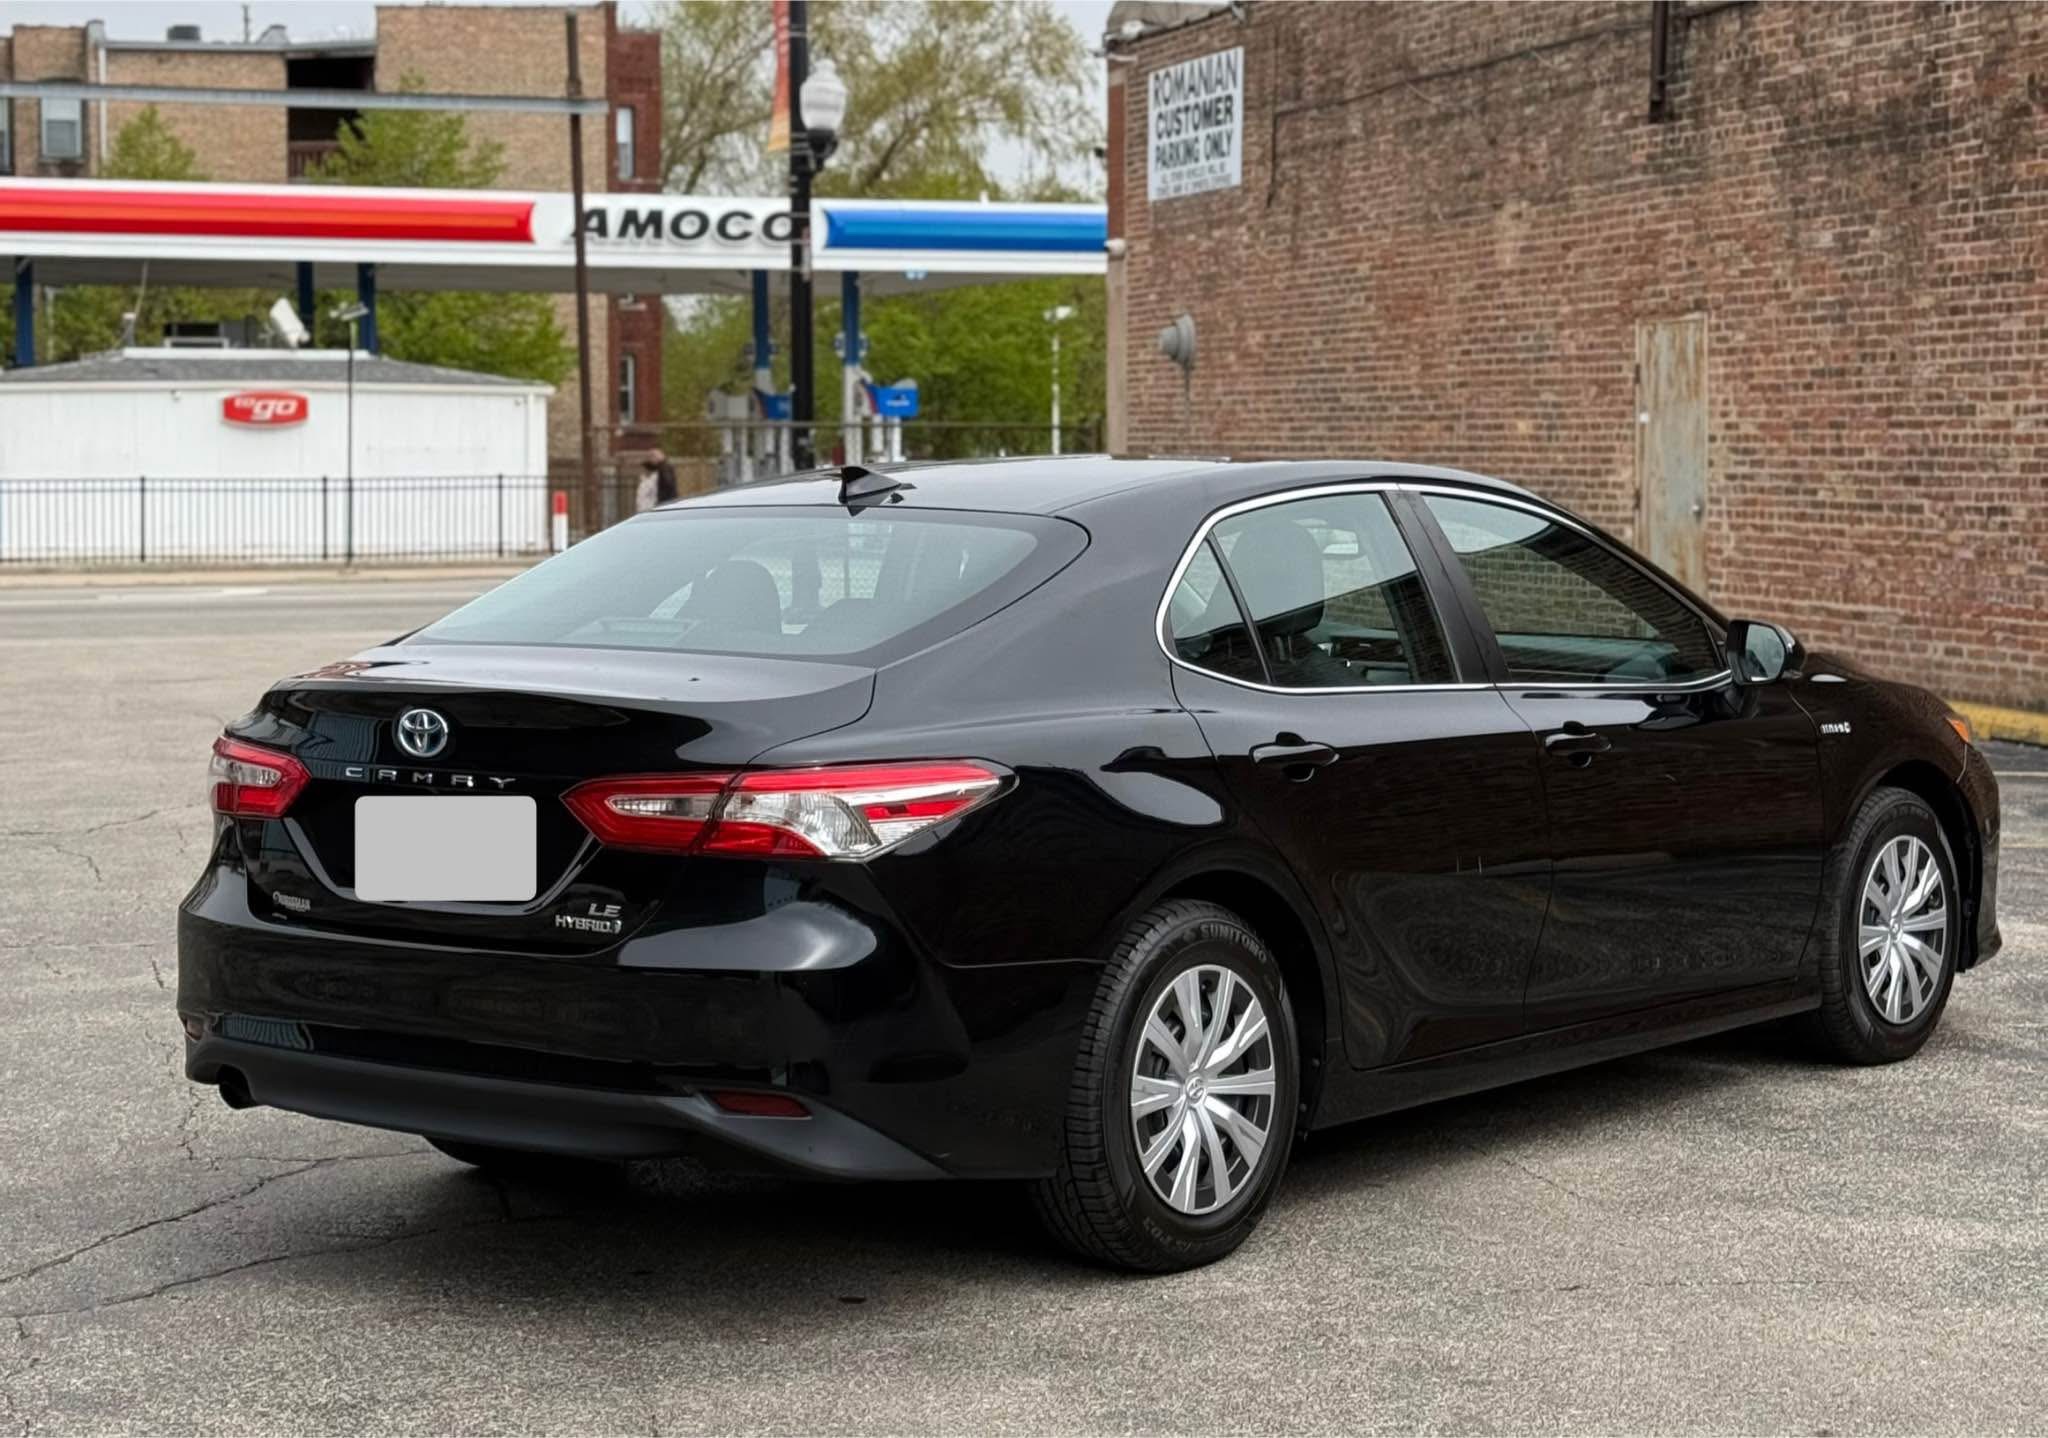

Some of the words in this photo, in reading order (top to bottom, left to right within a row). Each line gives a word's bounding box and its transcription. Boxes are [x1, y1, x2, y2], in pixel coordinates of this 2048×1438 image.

[1155, 95, 1233, 140] CUSTOMER
[1155, 135, 1200, 172] PARKING
[1204, 129, 1233, 161] ONLY
[572, 208, 793, 242] AMOCO
[252, 400, 299, 420] go
[345, 767, 517, 789] CAMRY
[555, 914, 611, 933] HYBRID
[588, 903, 621, 917] LE
[1200, 923, 1267, 963] SUMITOMO
